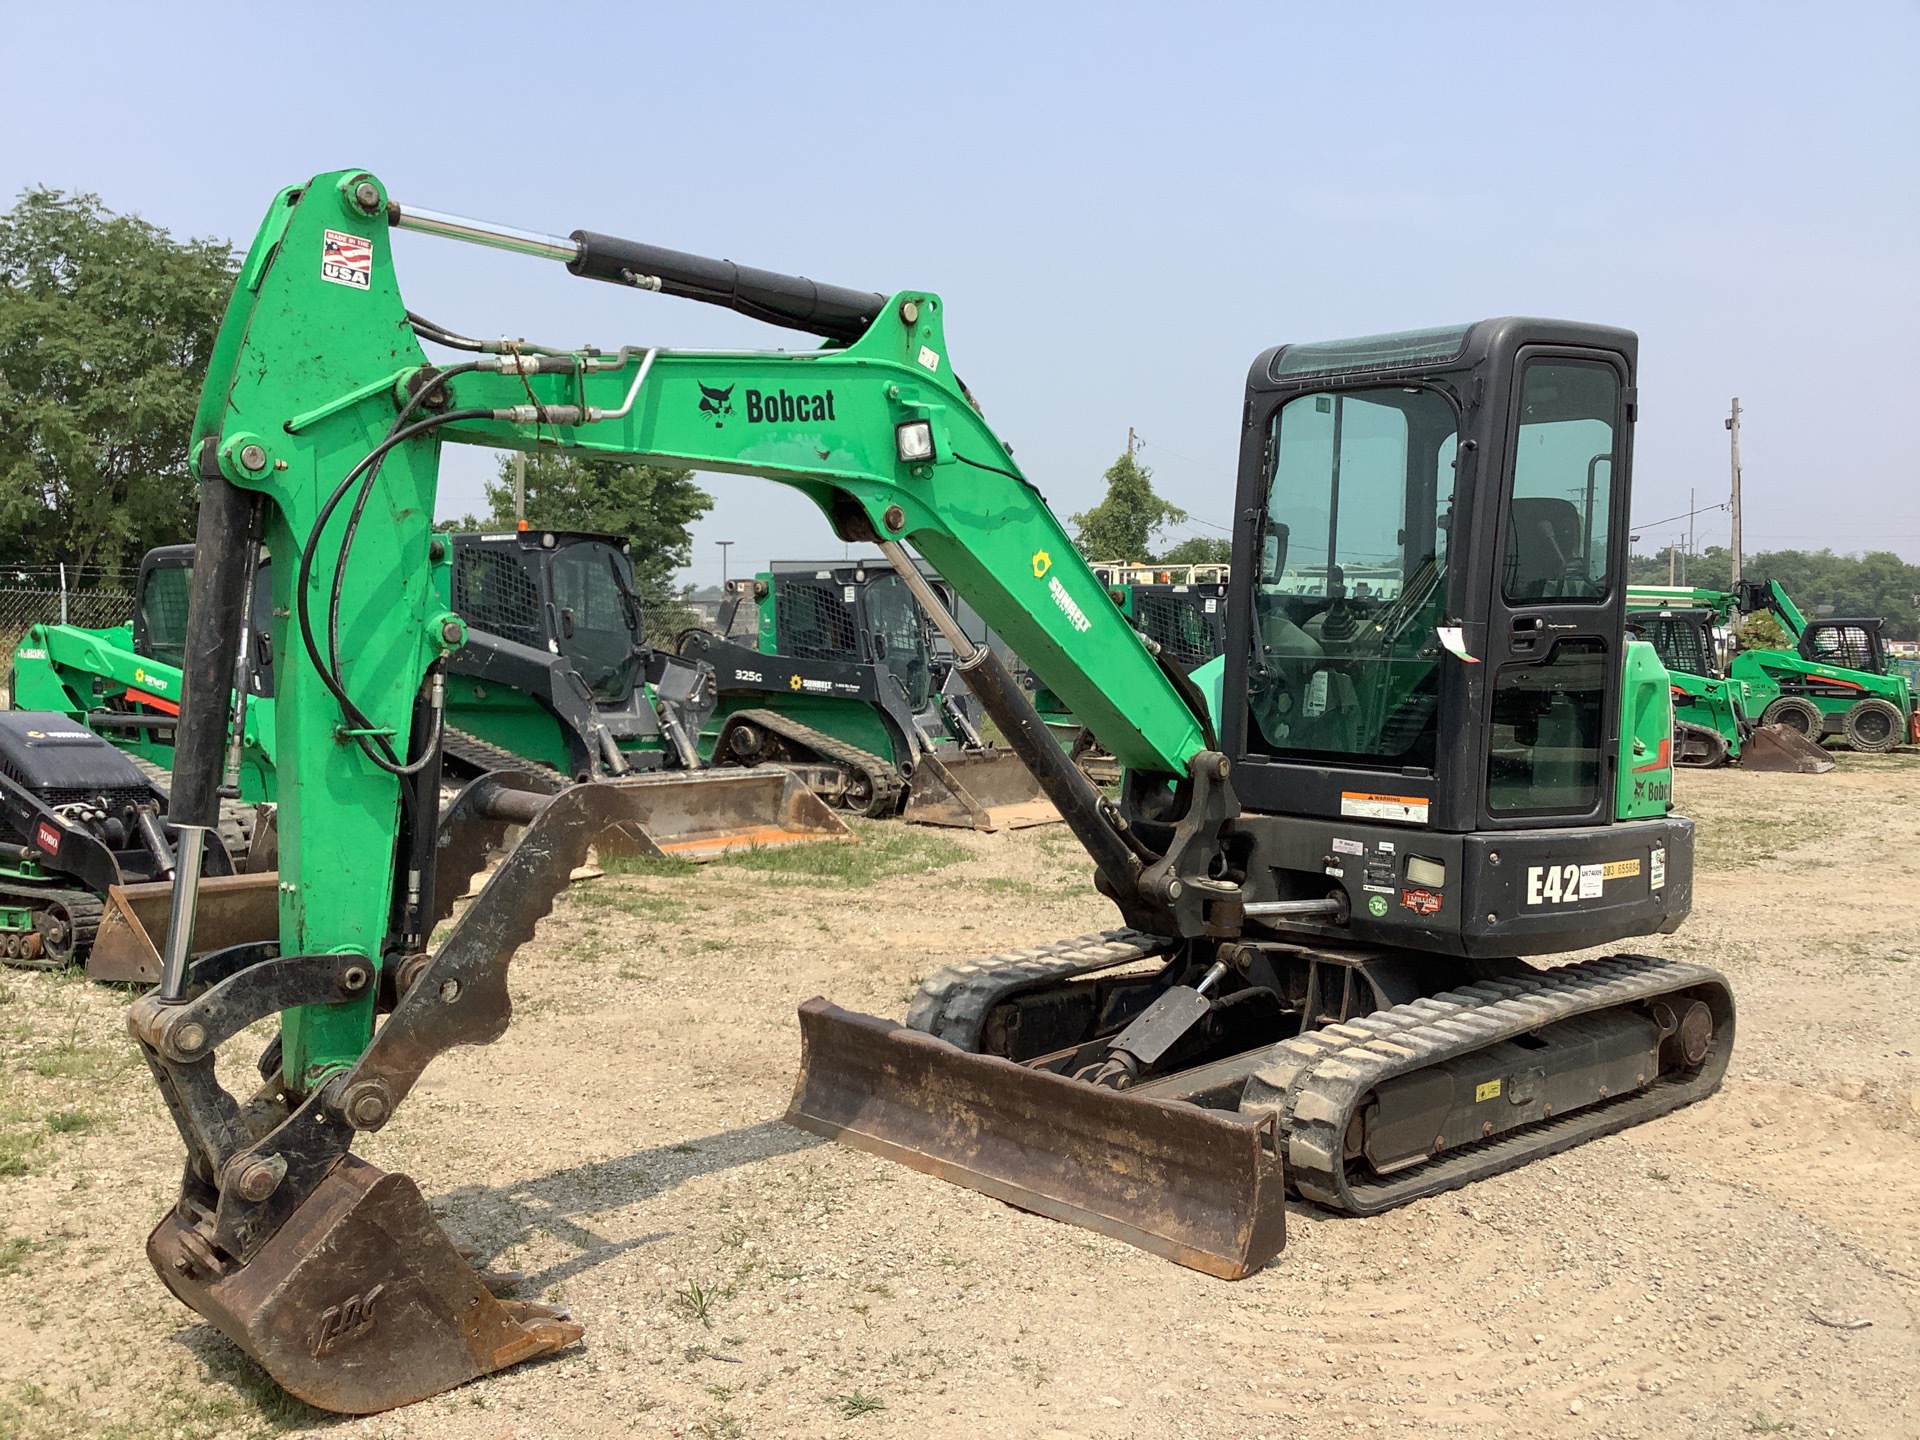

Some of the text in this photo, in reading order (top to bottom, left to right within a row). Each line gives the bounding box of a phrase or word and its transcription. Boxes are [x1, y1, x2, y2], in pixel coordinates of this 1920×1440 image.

[327, 232, 370, 248] MADE IN THE
[325, 264, 368, 284] USA
[745, 389, 836, 423] Bobcat
[1048, 576, 1092, 632] SUNBELT
[735, 669, 763, 683] 325G
[803, 680, 832, 689] SUNBELT
[40, 828, 58, 849] TORO
[1527, 864, 1580, 905] E42
